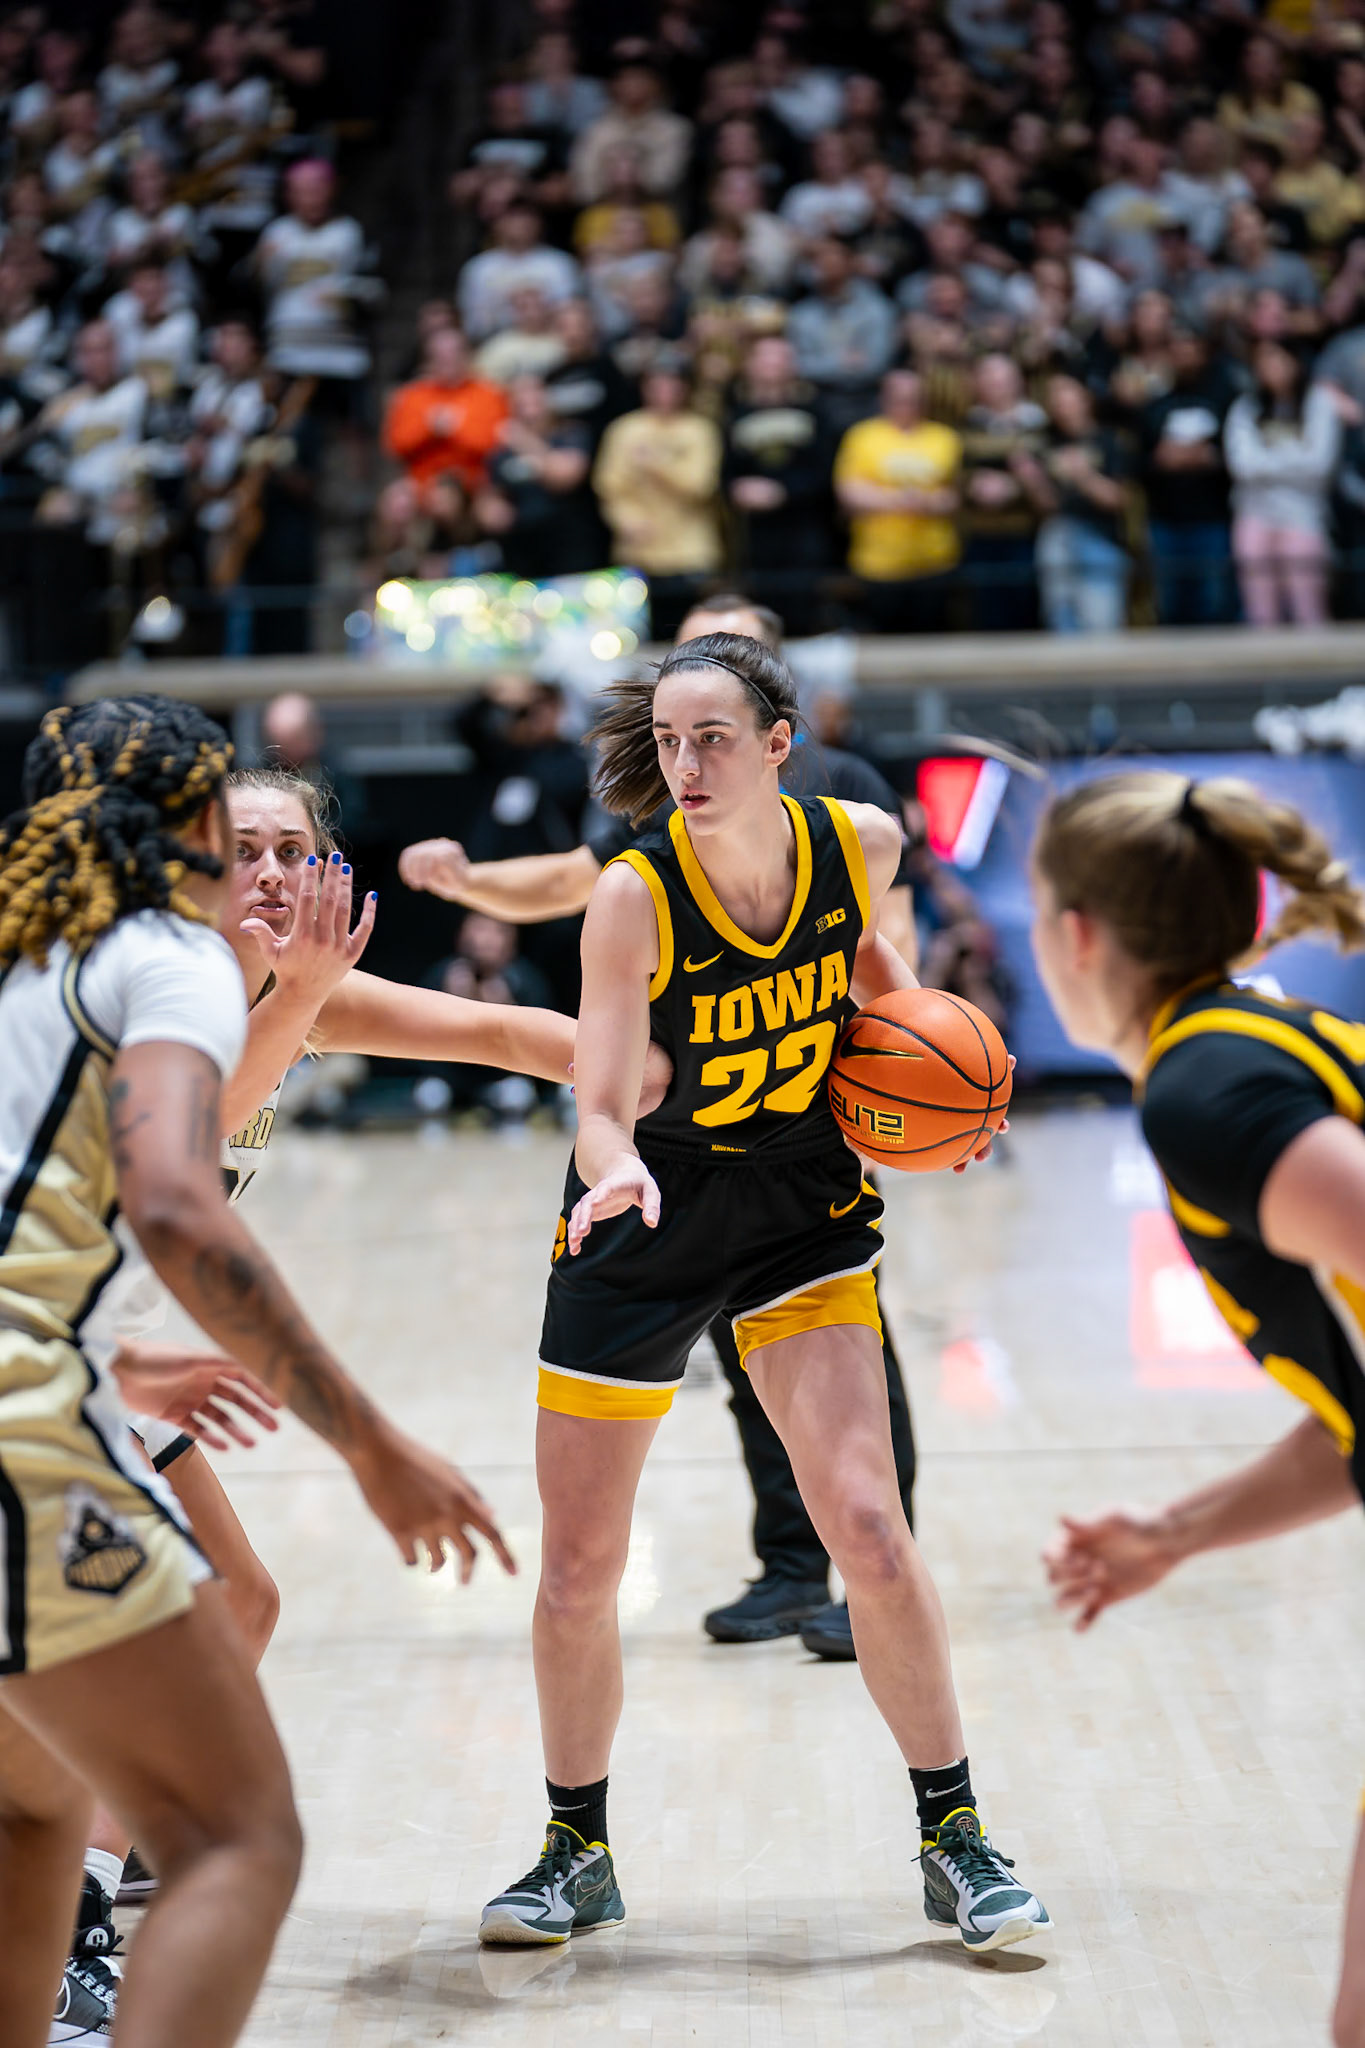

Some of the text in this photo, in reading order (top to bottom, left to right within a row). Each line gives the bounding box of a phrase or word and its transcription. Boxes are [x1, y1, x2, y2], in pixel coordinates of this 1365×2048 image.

[689, 950, 848, 1043] IOWA
[692, 1020, 836, 1127] 22
[830, 1084, 904, 1138] ELITE
